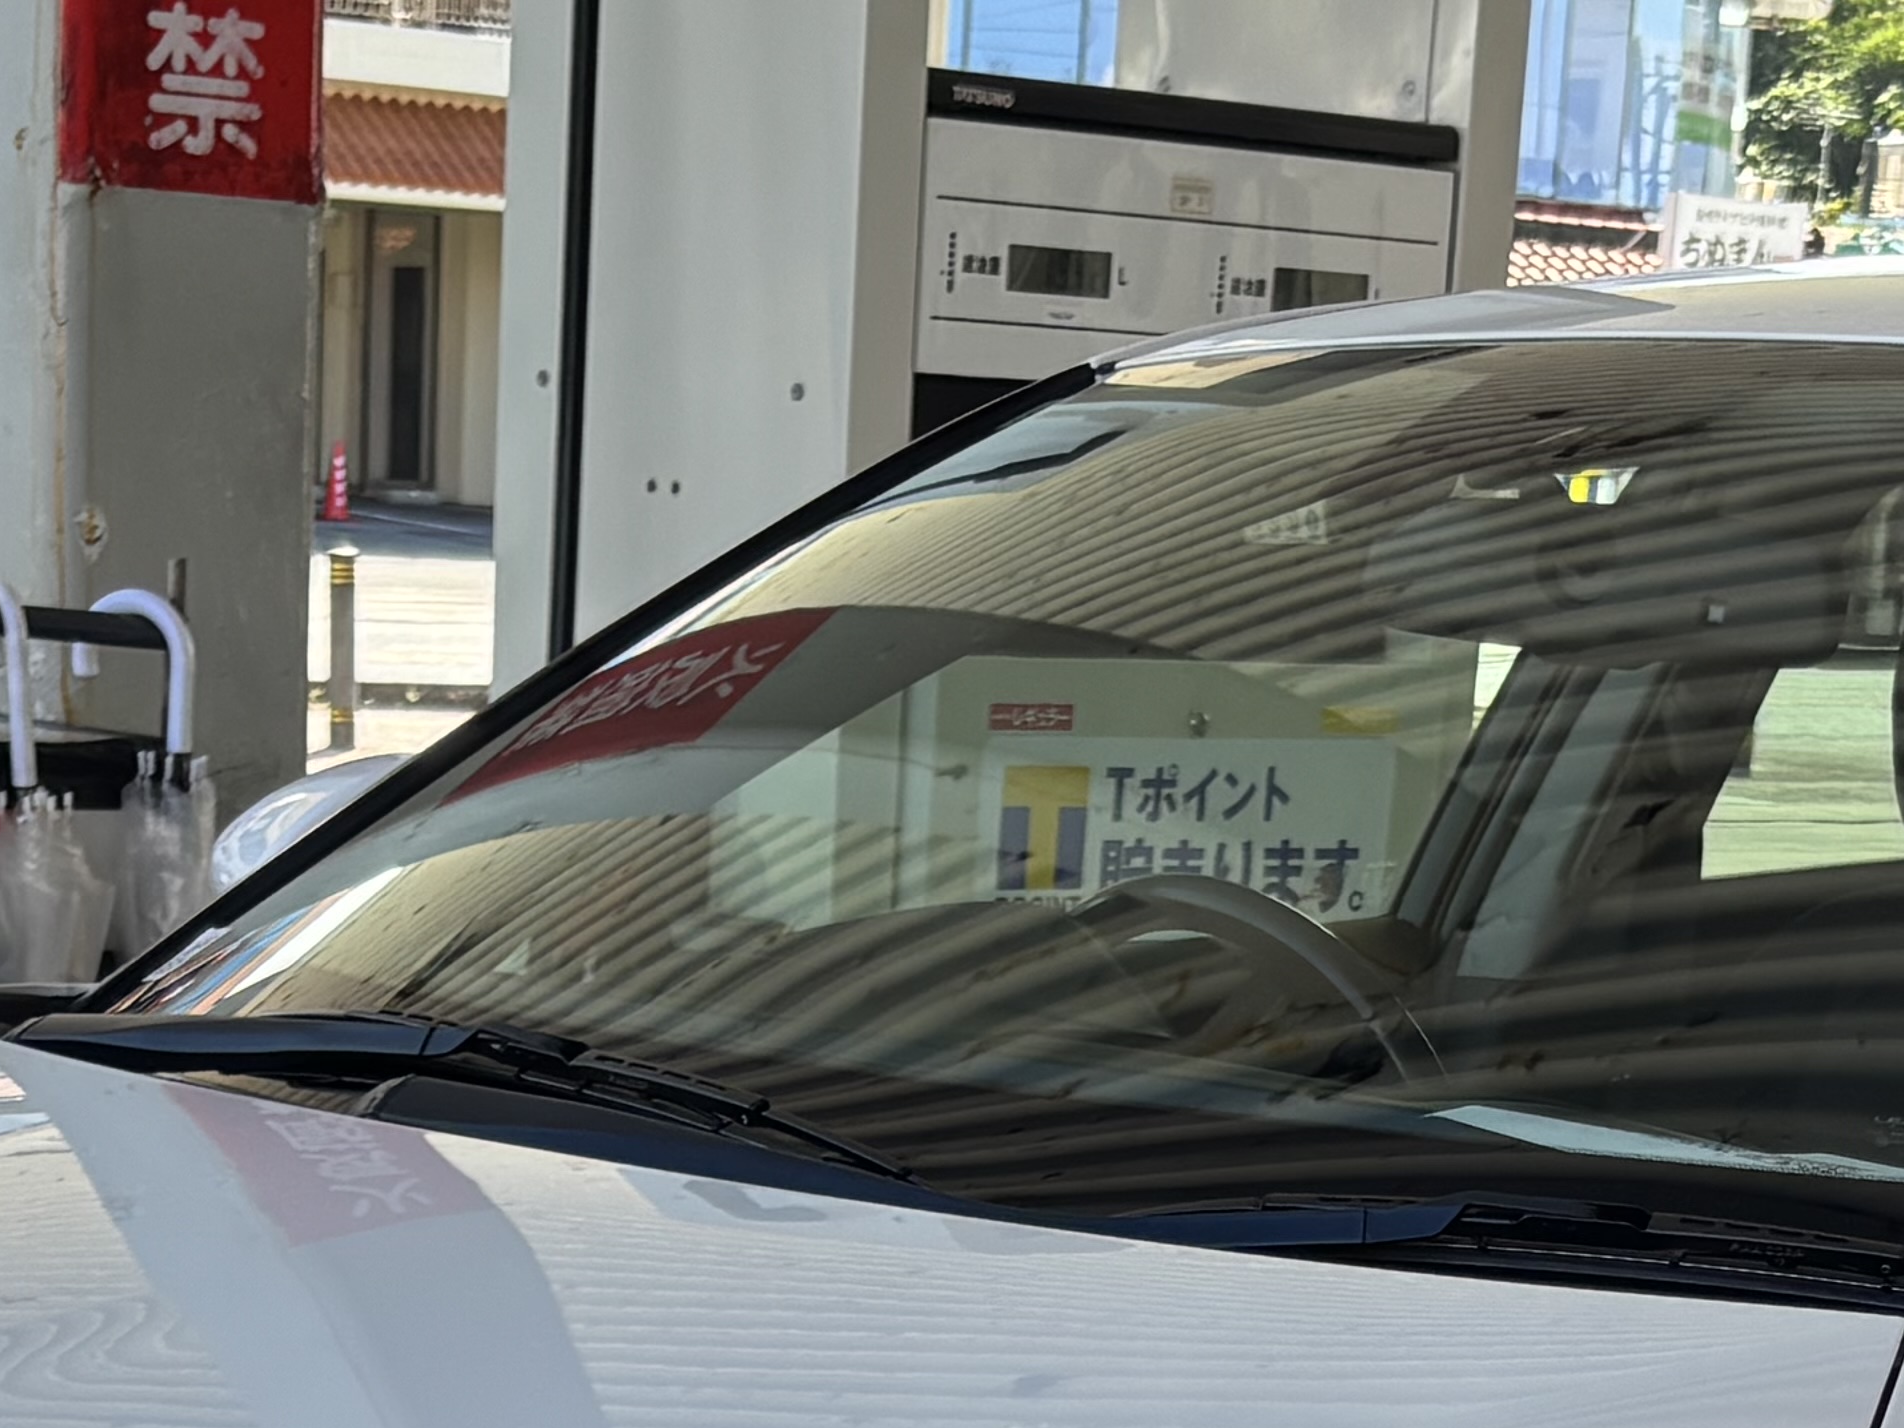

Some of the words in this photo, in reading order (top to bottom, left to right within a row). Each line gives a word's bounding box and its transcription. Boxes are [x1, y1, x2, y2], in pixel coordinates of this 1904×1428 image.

[145, 1, 266, 160] 禁
[1104, 763, 1293, 824] Tポイント
